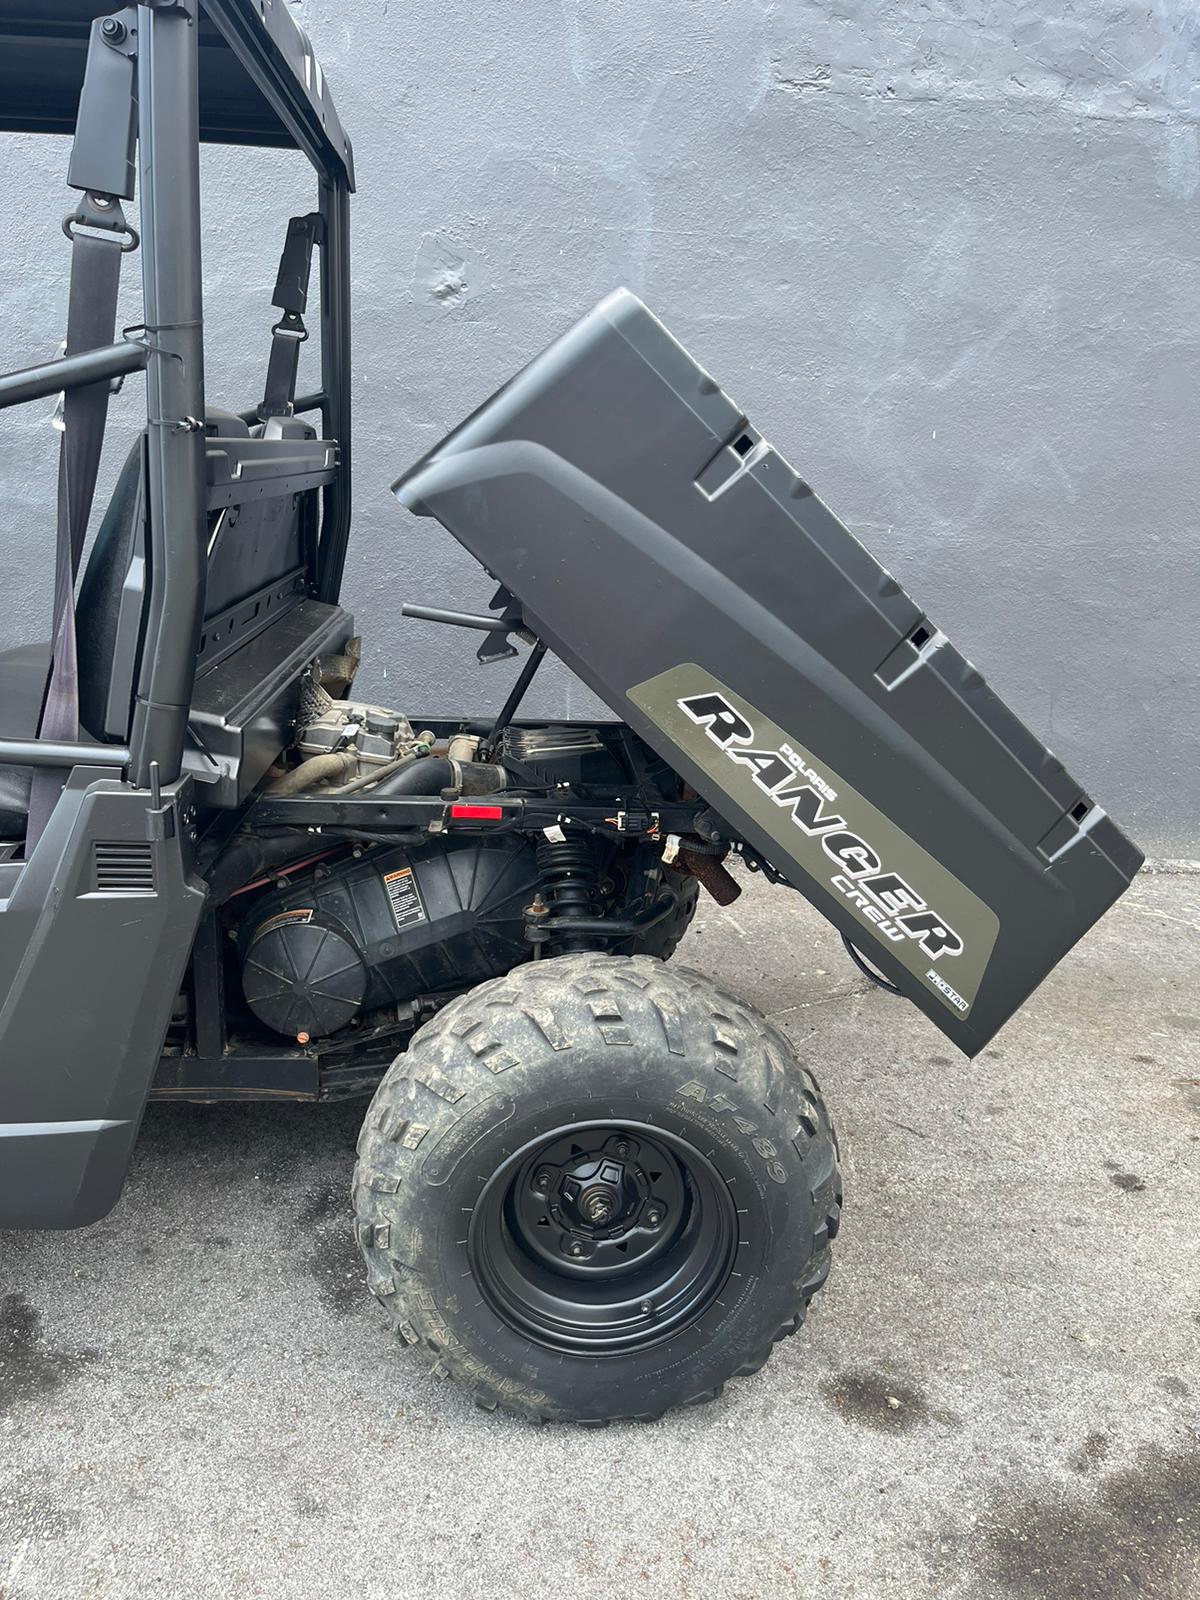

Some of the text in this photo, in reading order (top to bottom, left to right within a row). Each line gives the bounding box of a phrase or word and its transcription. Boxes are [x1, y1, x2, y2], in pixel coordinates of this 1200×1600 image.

[779, 742, 838, 802] POLARIS
[676, 691, 964, 961] RANGER
[830, 875, 905, 942] CREW
[416, 1291, 546, 1403] CARLISLE
